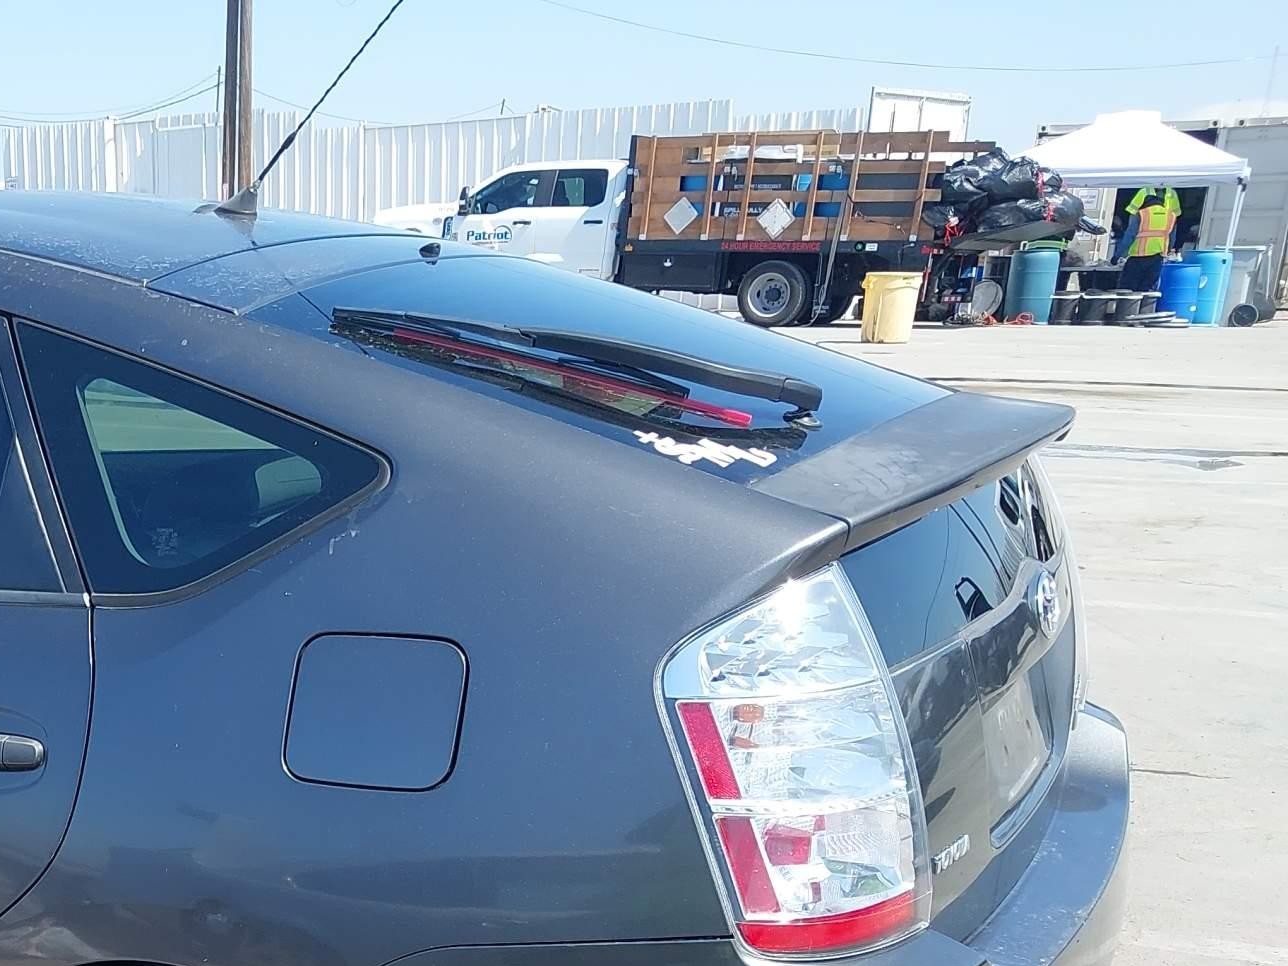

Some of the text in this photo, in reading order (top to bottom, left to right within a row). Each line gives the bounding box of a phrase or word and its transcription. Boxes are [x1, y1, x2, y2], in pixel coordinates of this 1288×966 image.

[467, 230, 510, 241] Patriot
[730, 242, 748, 250] HOUR
[750, 242, 790, 250] EMERGENCY
[791, 242, 821, 251] SERVICE
